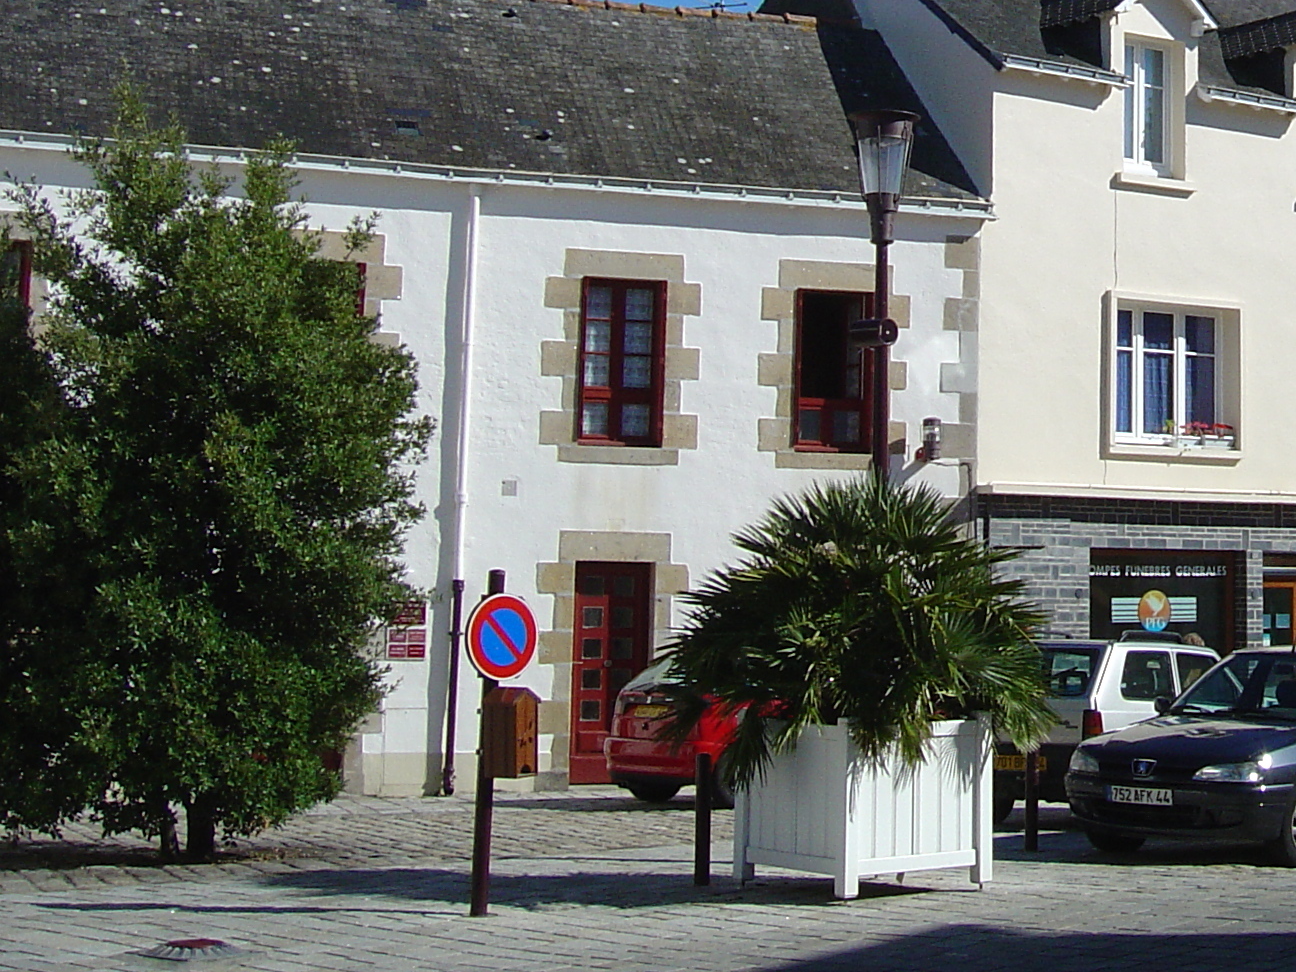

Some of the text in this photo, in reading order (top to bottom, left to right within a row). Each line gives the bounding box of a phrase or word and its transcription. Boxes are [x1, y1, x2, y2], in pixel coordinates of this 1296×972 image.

[1089, 565, 1227, 577] OMPES FUNEBRES GENERALES
[1145, 617, 1165, 628] PFG
[1112, 787, 1171, 804] 752 AFK 44
